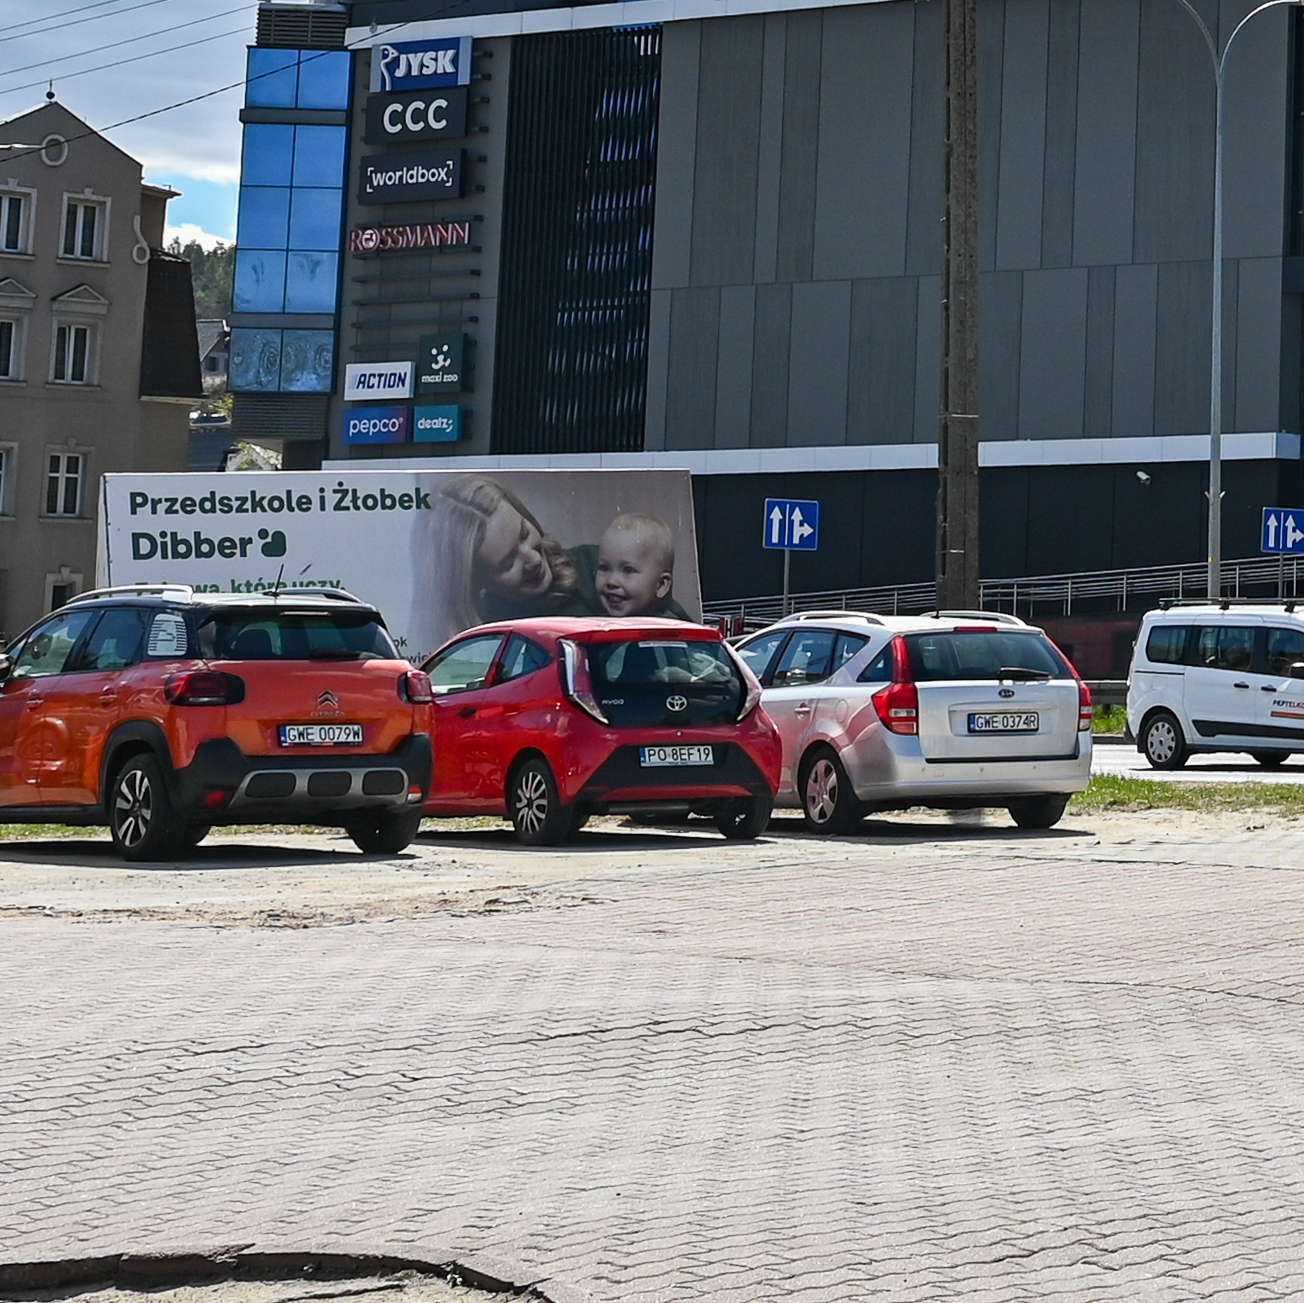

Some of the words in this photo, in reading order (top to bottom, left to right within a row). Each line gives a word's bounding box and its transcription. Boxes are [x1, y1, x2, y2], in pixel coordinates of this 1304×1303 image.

[394, 48, 456, 78] JYSK
[383, 98, 449, 134] CCC
[371, 165, 448, 187] worldbox
[350, 222, 470, 251] ROSSMANN
[355, 371, 408, 390] ACTION
[442, 373, 459, 383] zoo
[348, 417, 400, 437] pepco
[129, 490, 313, 516] Przedszkole
[318, 486, 327, 512] i
[332, 480, 432, 512] Żłobek
[131, 531, 254, 561] Dibber
[976, 715, 999, 729] GWE
[1002, 714, 1037, 729] 0374R
[287, 726, 315, 742] GWE
[318, 726, 361, 741] 0079W
[647, 748, 667, 762] PO
[671, 747, 711, 761] 8EF19
